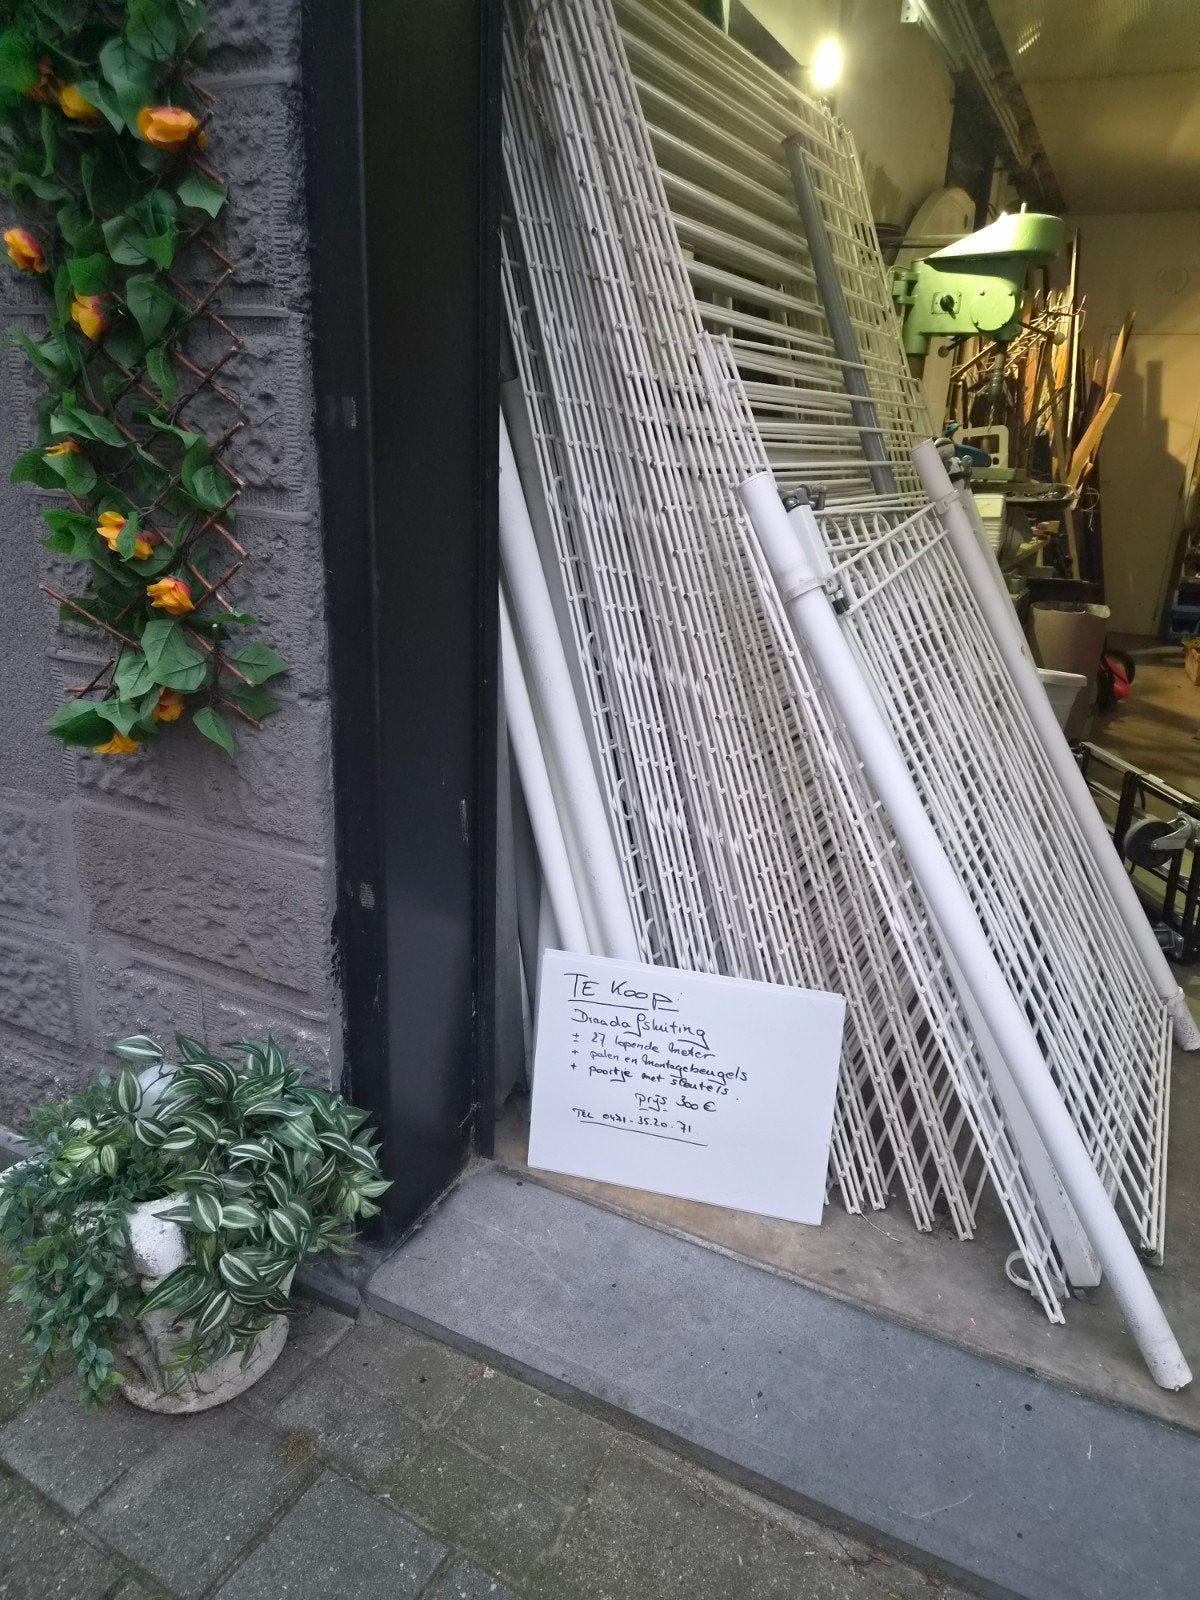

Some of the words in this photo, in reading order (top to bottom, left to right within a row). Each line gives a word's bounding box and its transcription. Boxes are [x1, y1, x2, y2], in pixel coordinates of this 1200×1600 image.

[564, 972, 600, 998] TE
[591, 1032, 606, 1047] 27
[615, 1035, 661, 1052] lopende
[668, 1041, 716, 1059] meter
[588, 1065, 633, 1083] poortje
[641, 1071, 665, 1083] met
[669, 1077, 729, 1096] sleutels
[589, 1049, 619, 1061] palen
[624, 1055, 638, 1065] en
[641, 1053, 748, 1086] montagebeugels
[675, 1095, 699, 1111] 300
